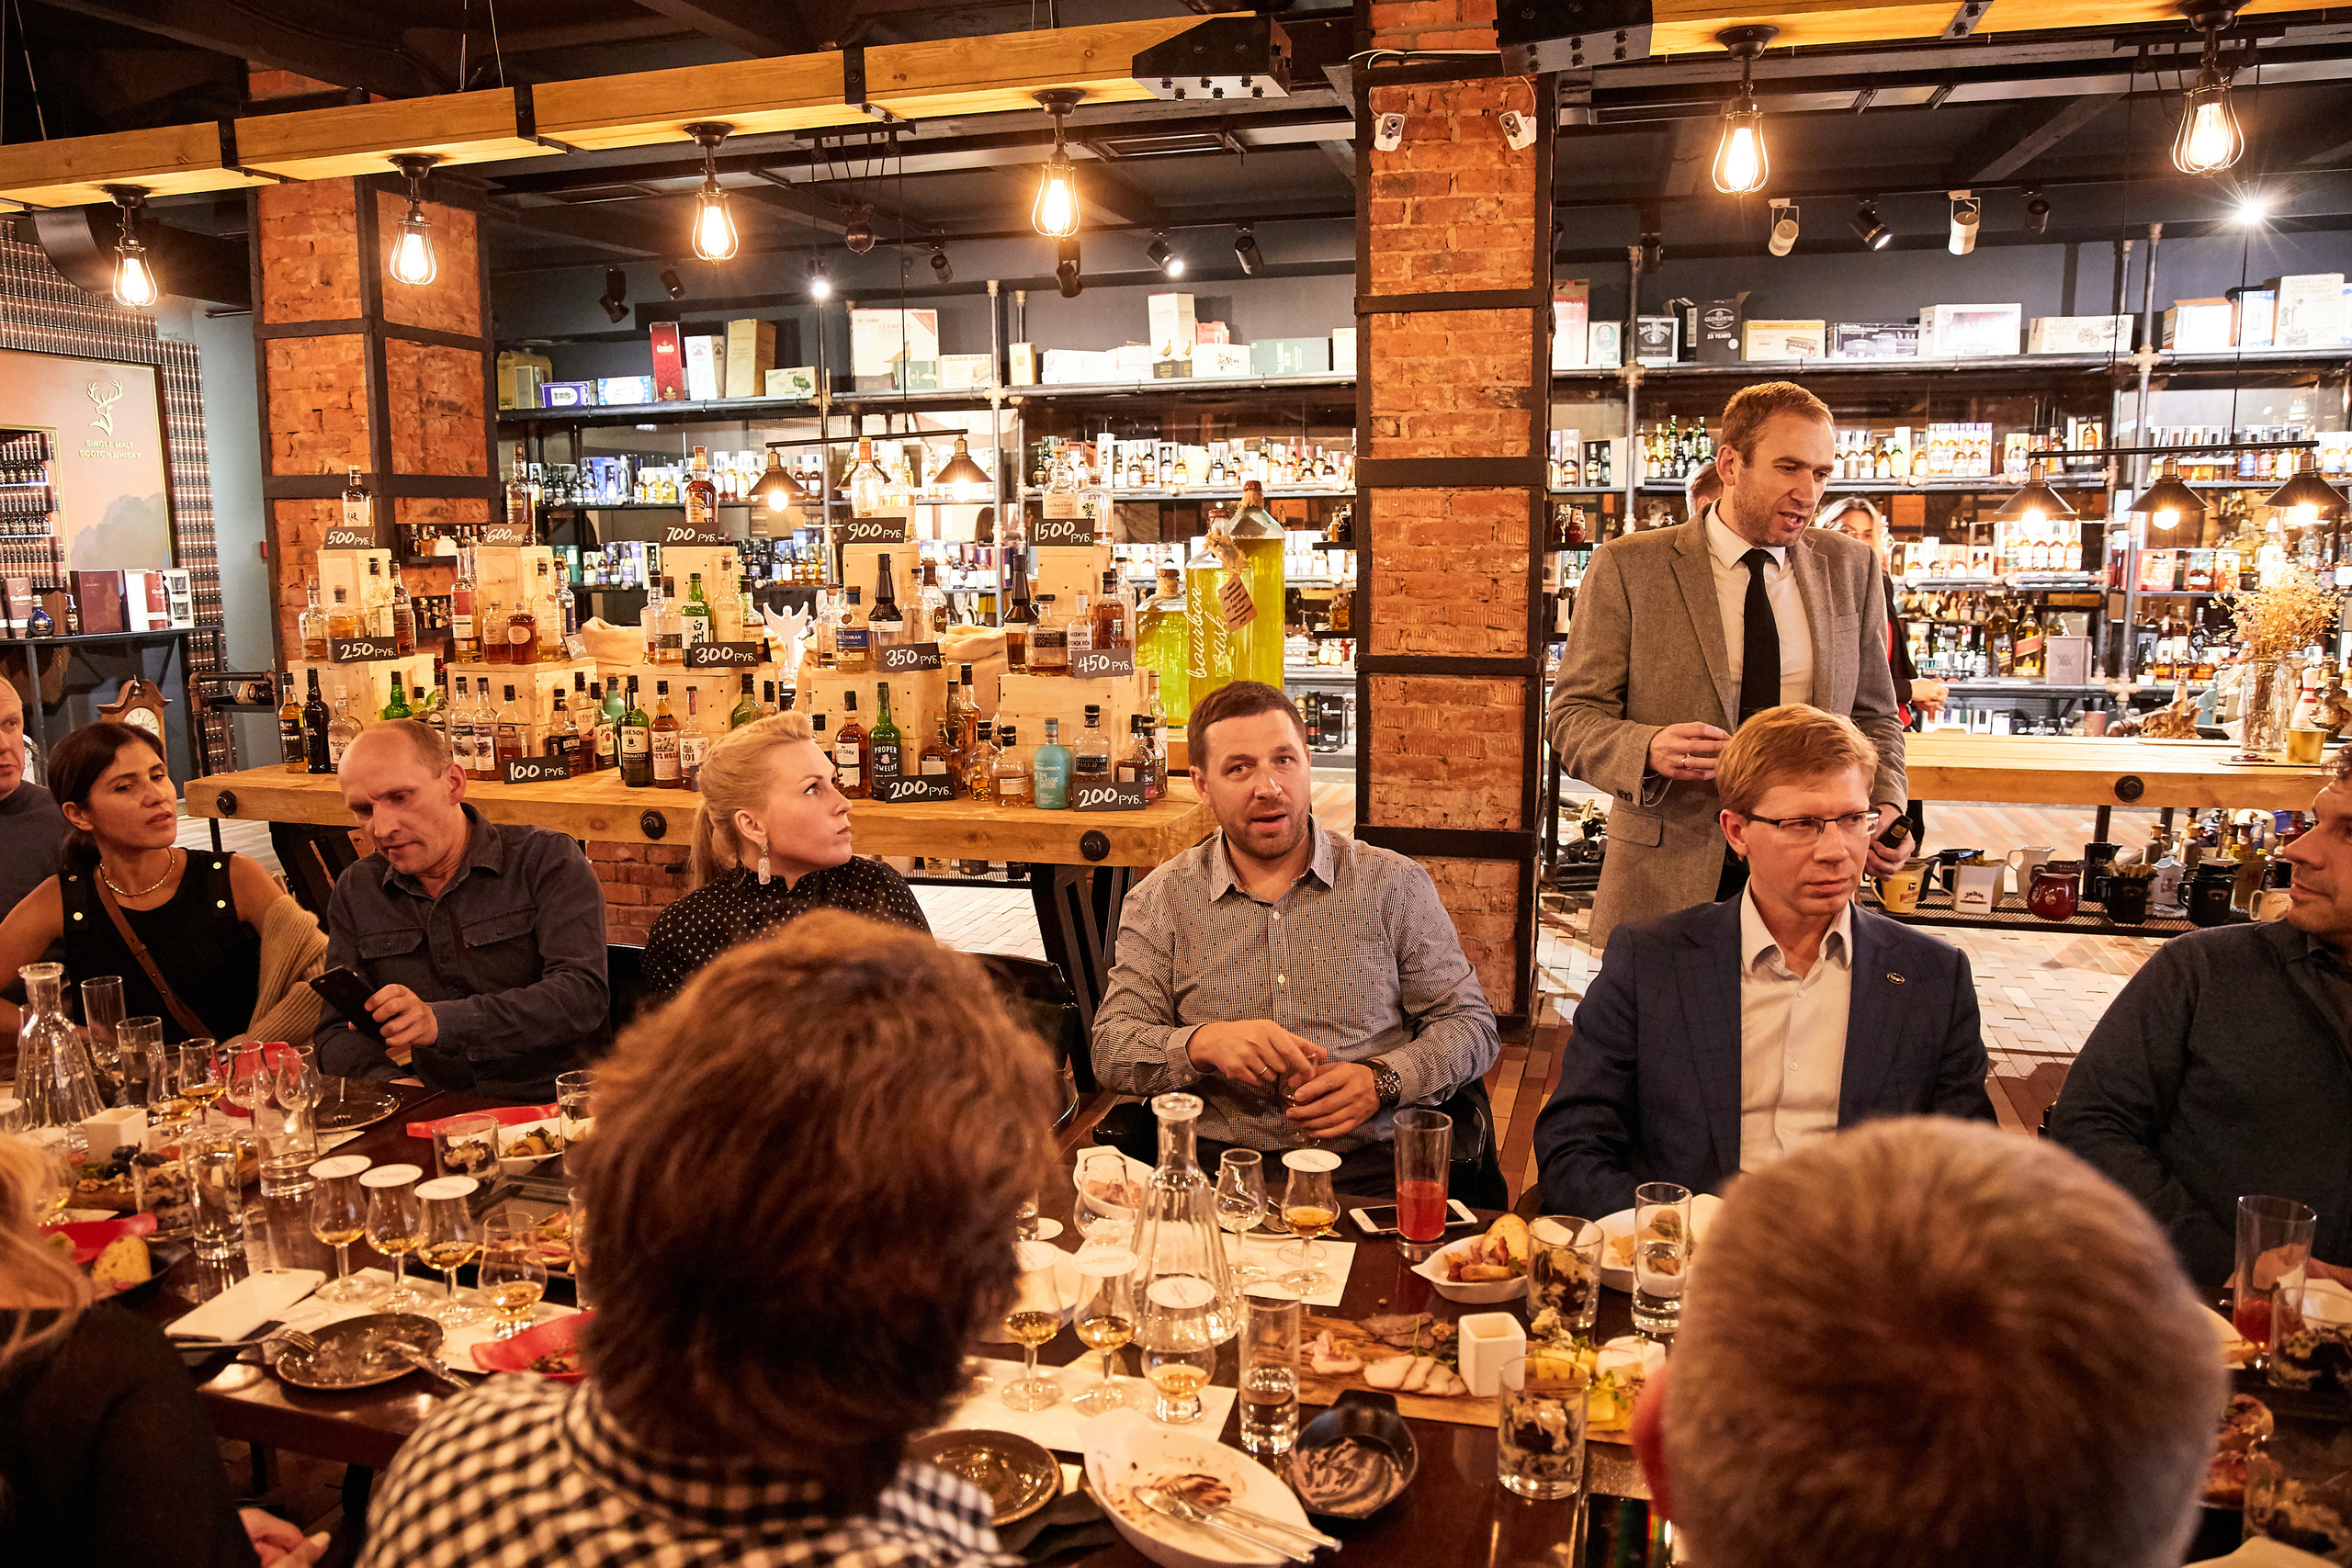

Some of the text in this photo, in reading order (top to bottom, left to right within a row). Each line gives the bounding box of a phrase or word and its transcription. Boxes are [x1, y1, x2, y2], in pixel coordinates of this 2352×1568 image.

[85, 440, 133, 449] SINGLE MALT
[79, 449, 141, 459] SCOTCH WHISKY
[327, 531, 356, 545] 500
[486, 528, 512, 543] 600
[666, 526, 695, 542] 700
[848, 523, 883, 541] 900
[1035, 521, 1076, 542] 1500
[1184, 585, 1208, 679] bourbon
[1204, 610, 1230, 666] cask
[340, 643, 375, 660] 250
[695, 647, 734, 663] 300
[886, 649, 918, 667] 350
[1078, 655, 1110, 672] 450
[875, 745, 898, 754] PROPER
[510, 762, 540, 781] 100
[875, 763, 898, 773] TWELVE
[889, 780, 928, 800] 200
[1078, 787, 1118, 807] 200
